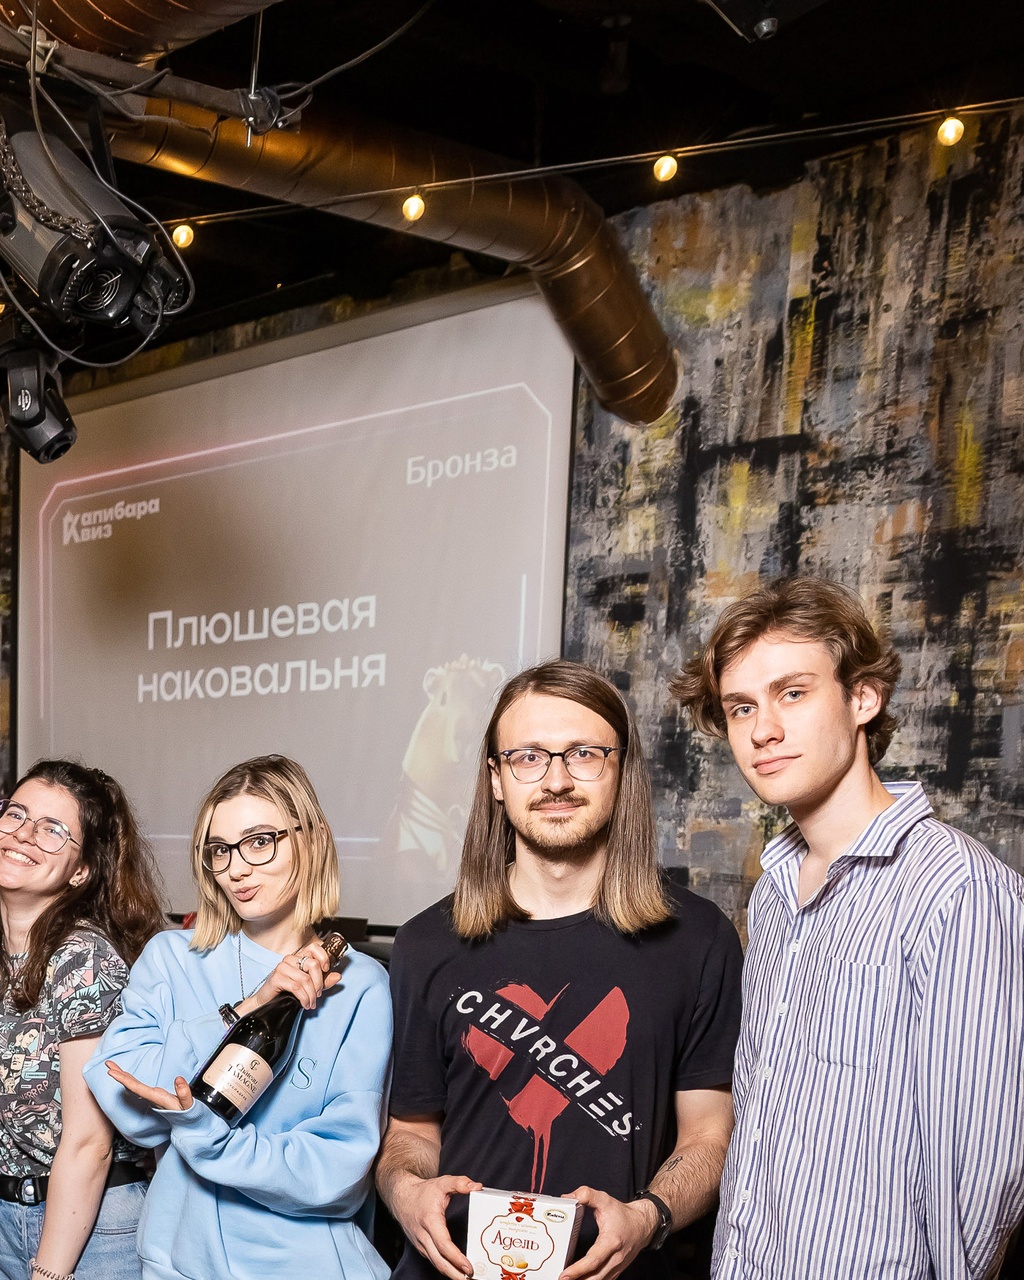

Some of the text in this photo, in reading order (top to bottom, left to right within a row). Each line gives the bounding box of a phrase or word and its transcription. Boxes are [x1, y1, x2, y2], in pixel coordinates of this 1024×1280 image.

[406, 444, 518, 488] Бронза
[147, 594, 377, 651] Плюшевая
[137, 653, 387, 703] наковальня
